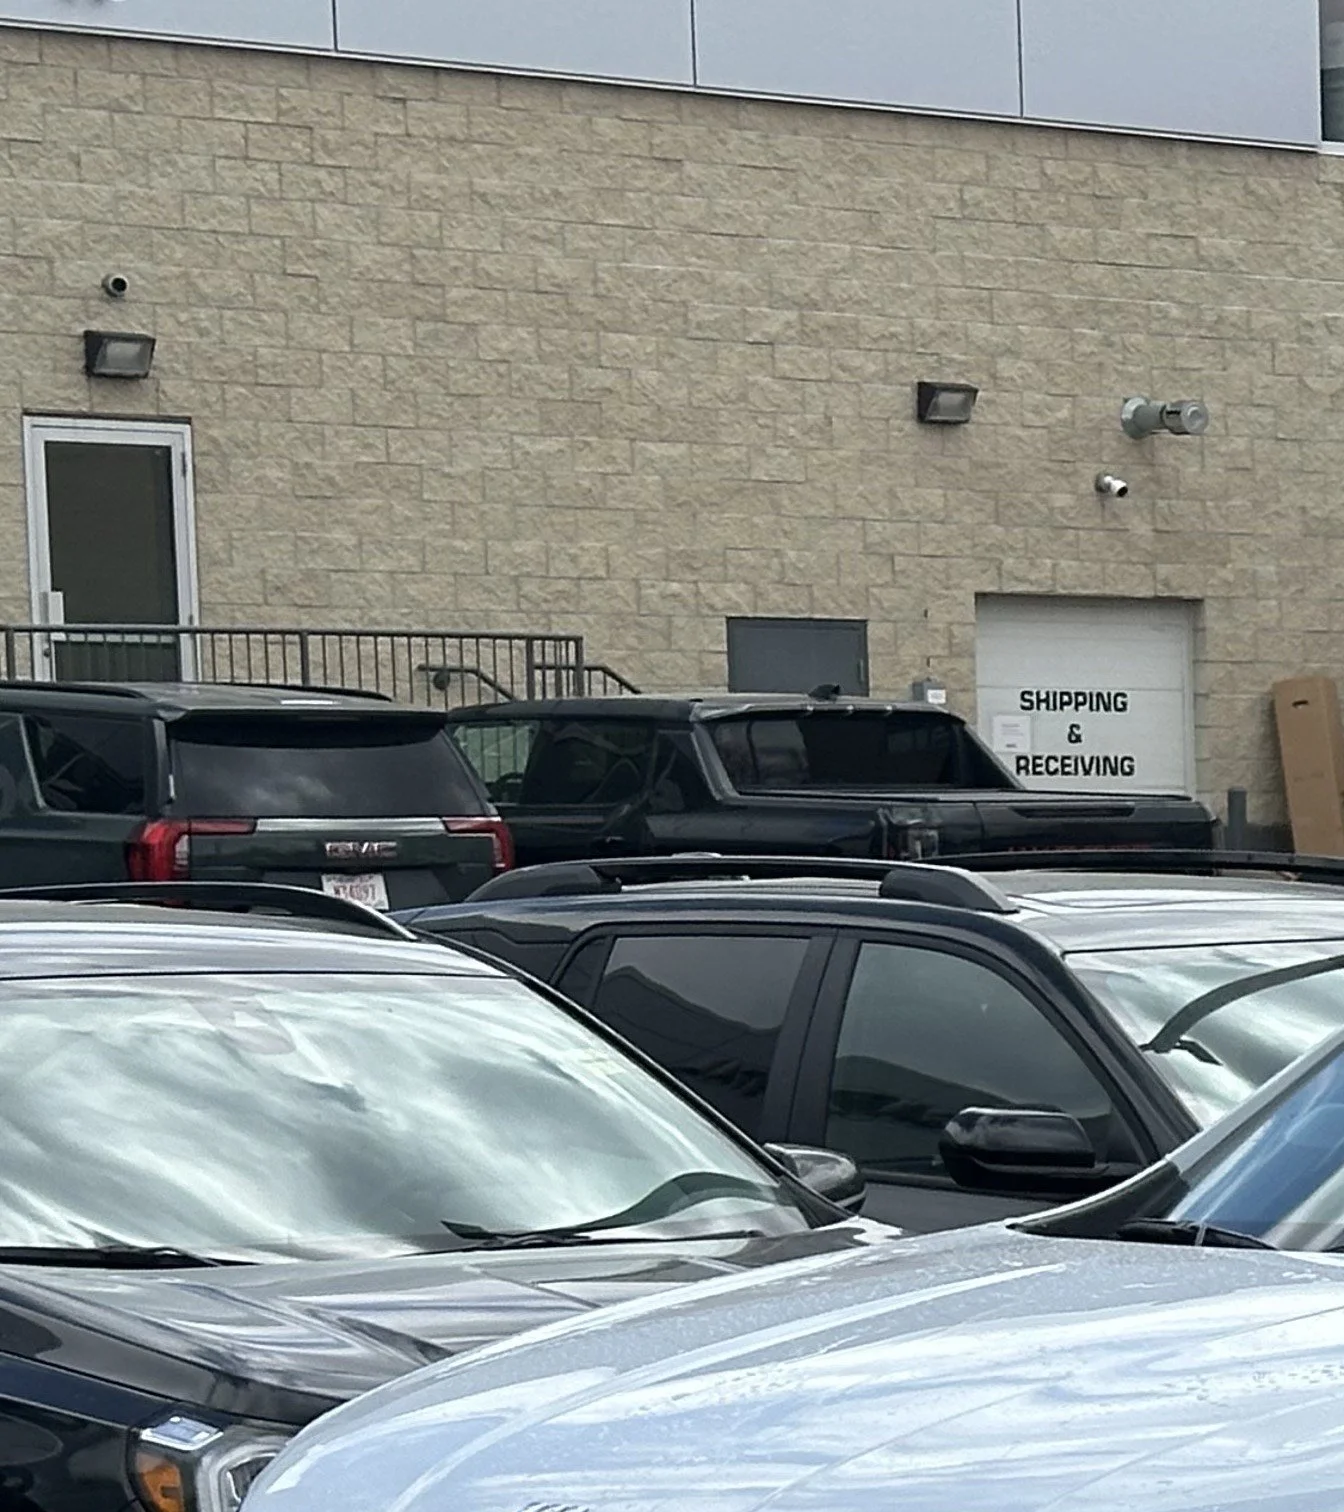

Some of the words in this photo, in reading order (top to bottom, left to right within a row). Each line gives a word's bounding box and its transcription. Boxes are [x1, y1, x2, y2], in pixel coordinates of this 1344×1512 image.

[1020, 690, 1128, 712] SHIPPING
[1067, 723, 1083, 744] &
[1015, 754, 1135, 776] RECEIVING
[325, 841, 397, 858] GMC
